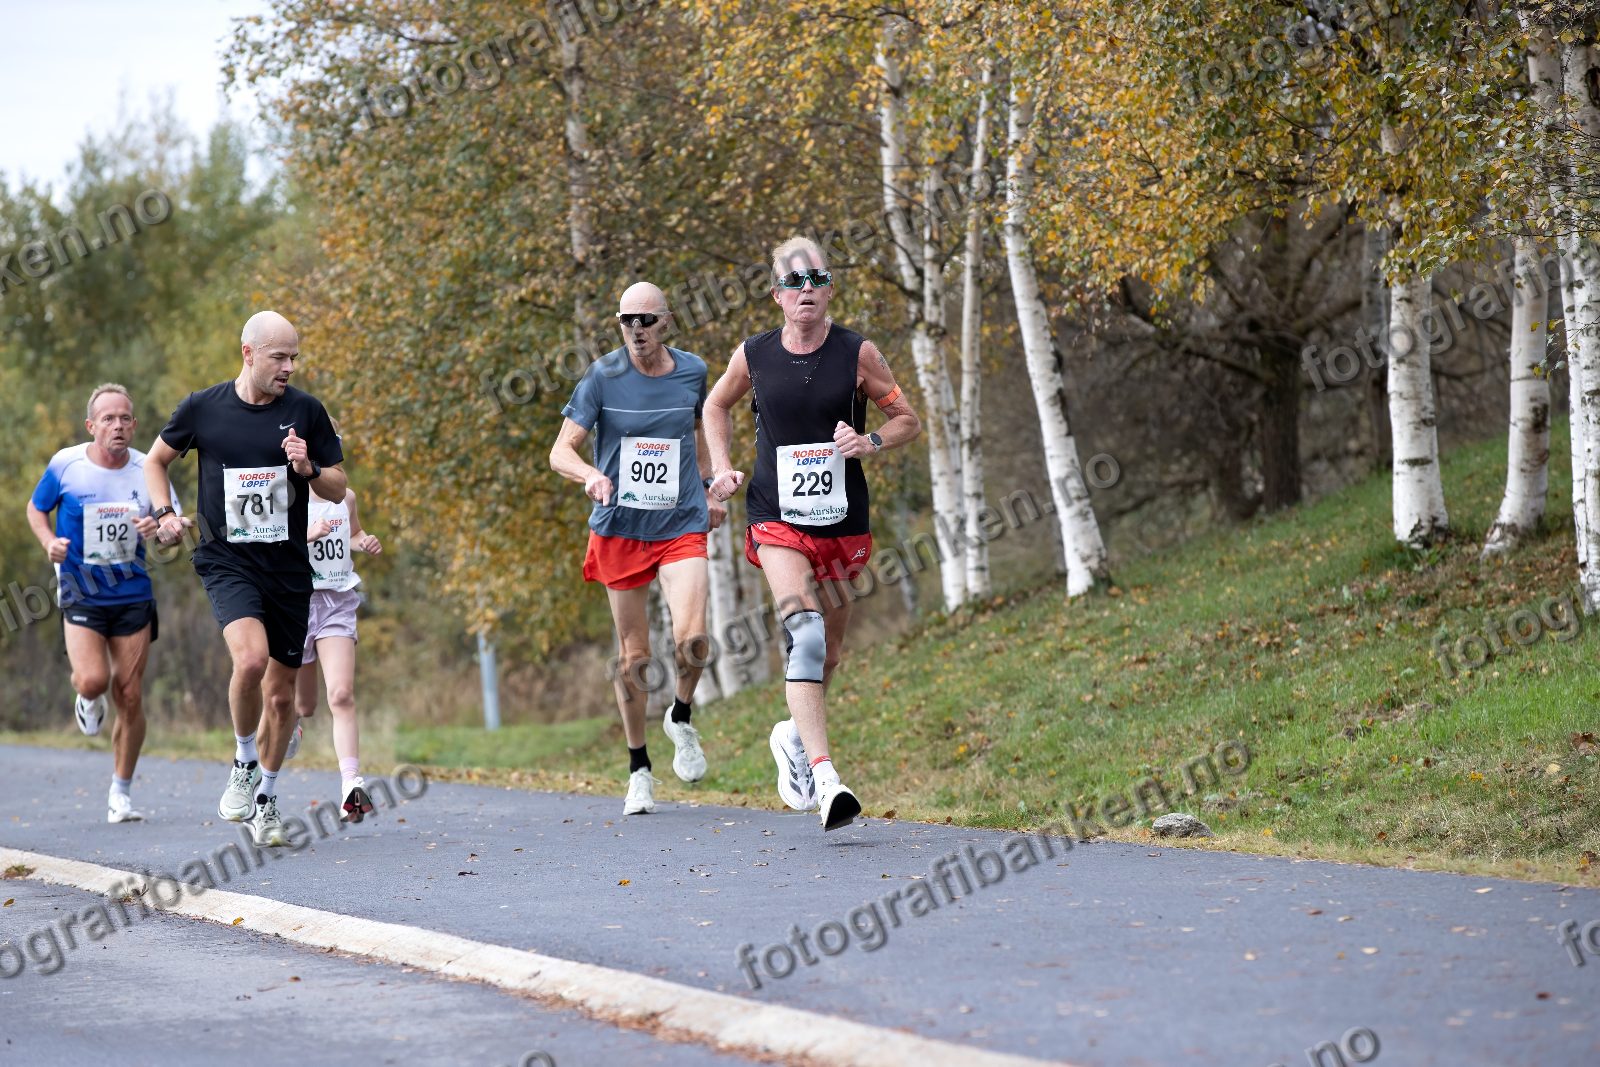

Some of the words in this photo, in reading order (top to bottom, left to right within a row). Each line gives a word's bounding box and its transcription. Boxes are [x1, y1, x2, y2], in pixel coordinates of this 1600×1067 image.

[635, 442, 670, 451] NORGES
[793, 449, 834, 458] NORGES
[797, 457, 828, 466] LØPET
[238, 472, 276, 480] NORGES
[631, 461, 668, 484] 902
[241, 480, 270, 488] LØPET
[792, 471, 833, 497] 229
[642, 493, 677, 503] Aurskog
[237, 493, 274, 516] 781
[809, 506, 846, 516] Aurskog
[96, 524, 128, 542] 192
[314, 539, 344, 561] 303
